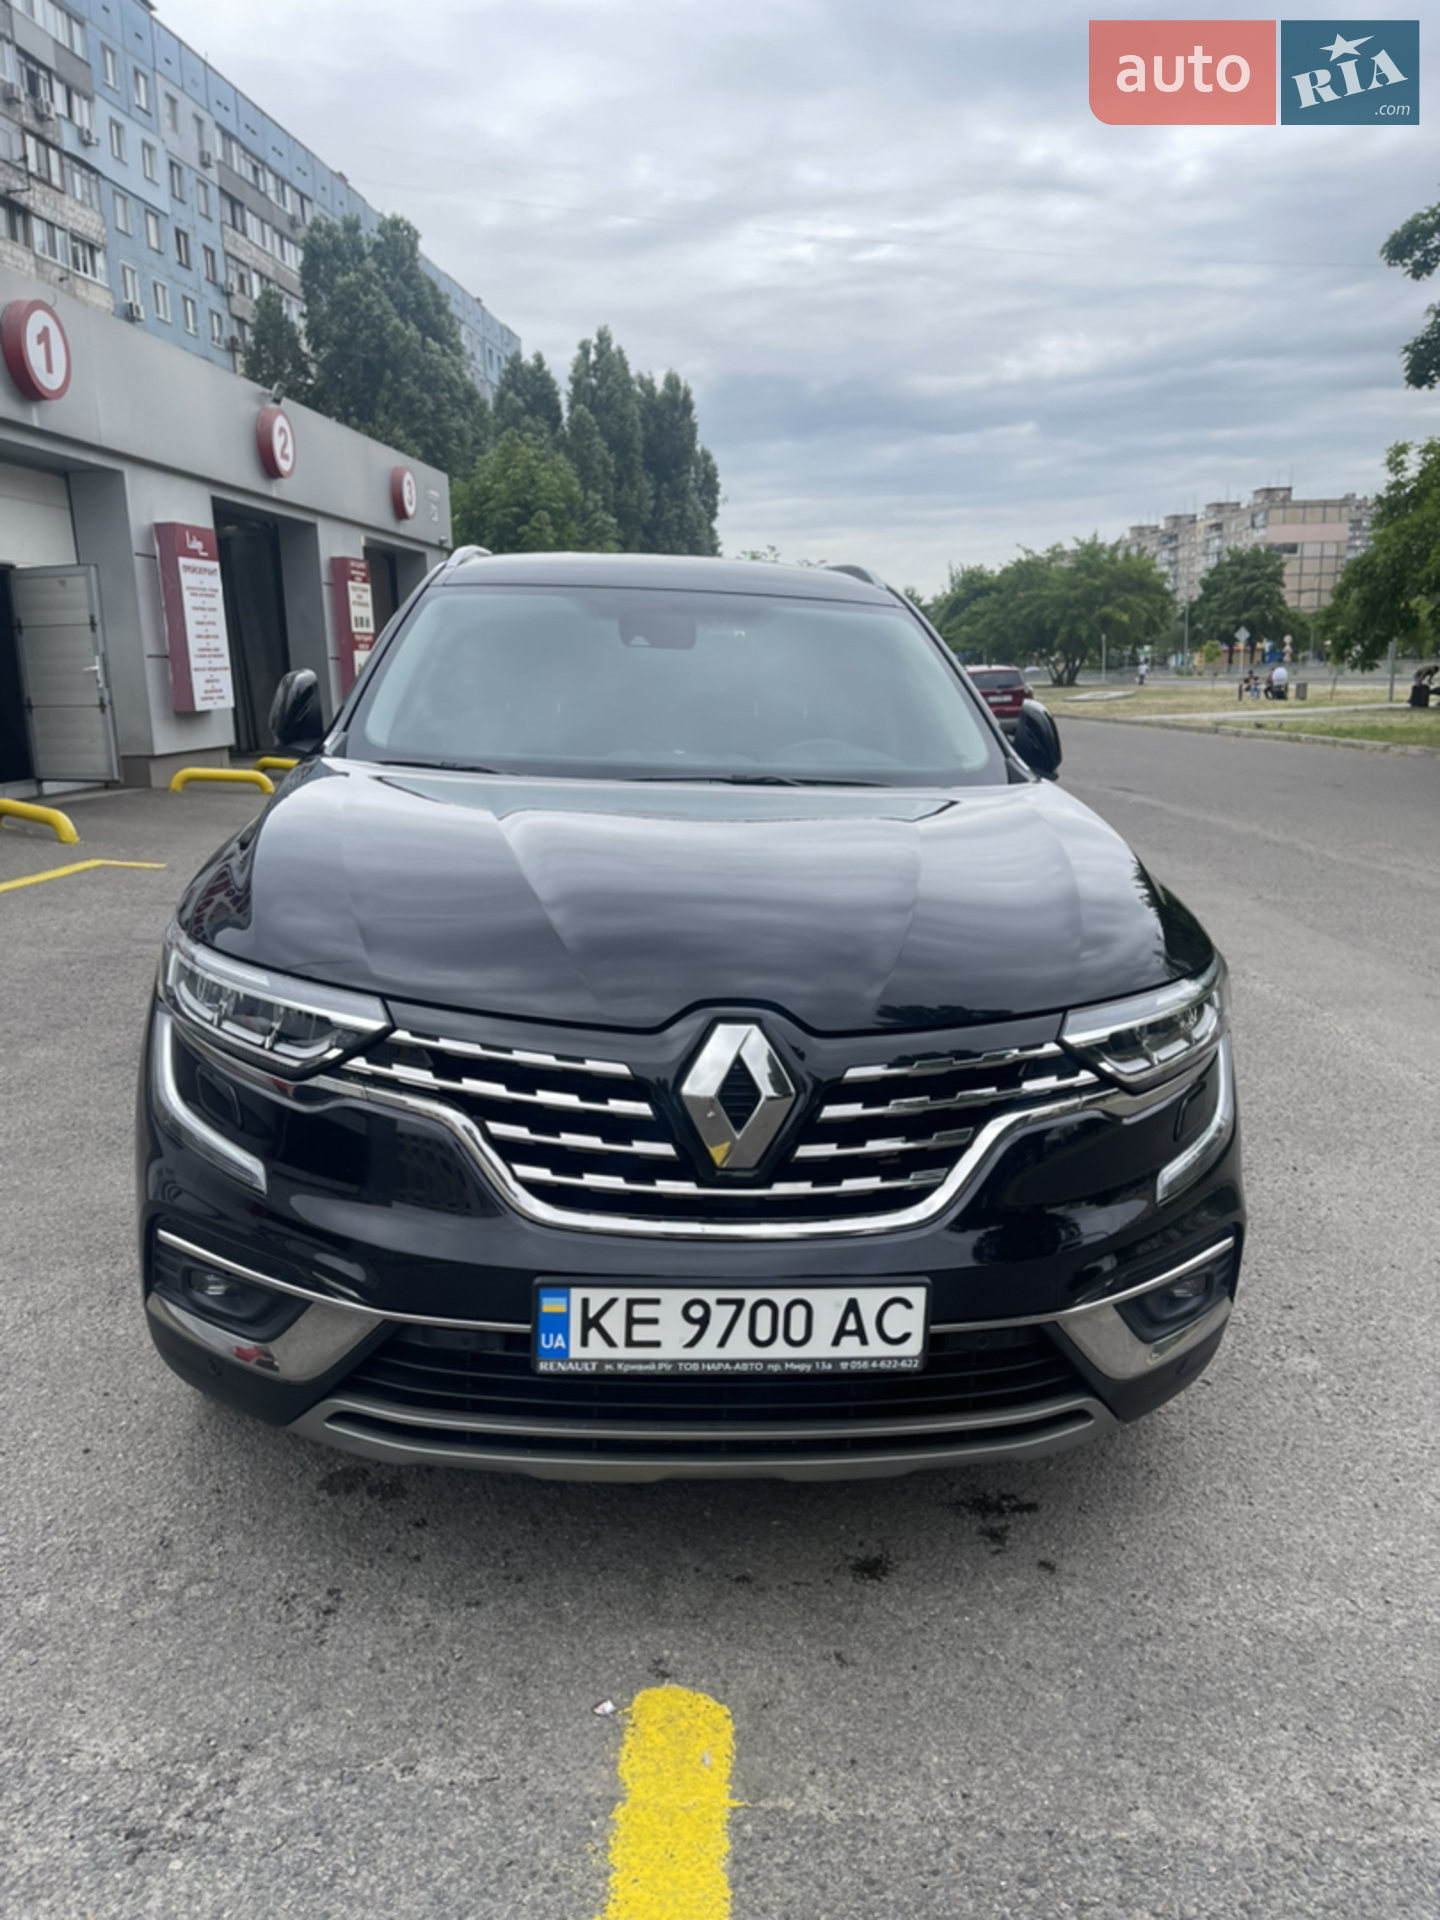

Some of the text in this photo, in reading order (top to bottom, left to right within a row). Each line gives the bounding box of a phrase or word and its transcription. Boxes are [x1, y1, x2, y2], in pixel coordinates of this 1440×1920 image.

[36, 324, 54, 375] 1
[278, 426, 290, 462] 2
[406, 479, 414, 507] 3
[580, 1296, 915, 1348] KE 9700 AC
[541, 1332, 566, 1349] UA
[539, 1361, 598, 1372] RENAULT
[616, 1362, 656, 1373] Кривий
[677, 1362, 700, 1372] ТОВ
[702, 1362, 763, 1372] НАРА-АВТО
[785, 1362, 812, 1372] Миру
